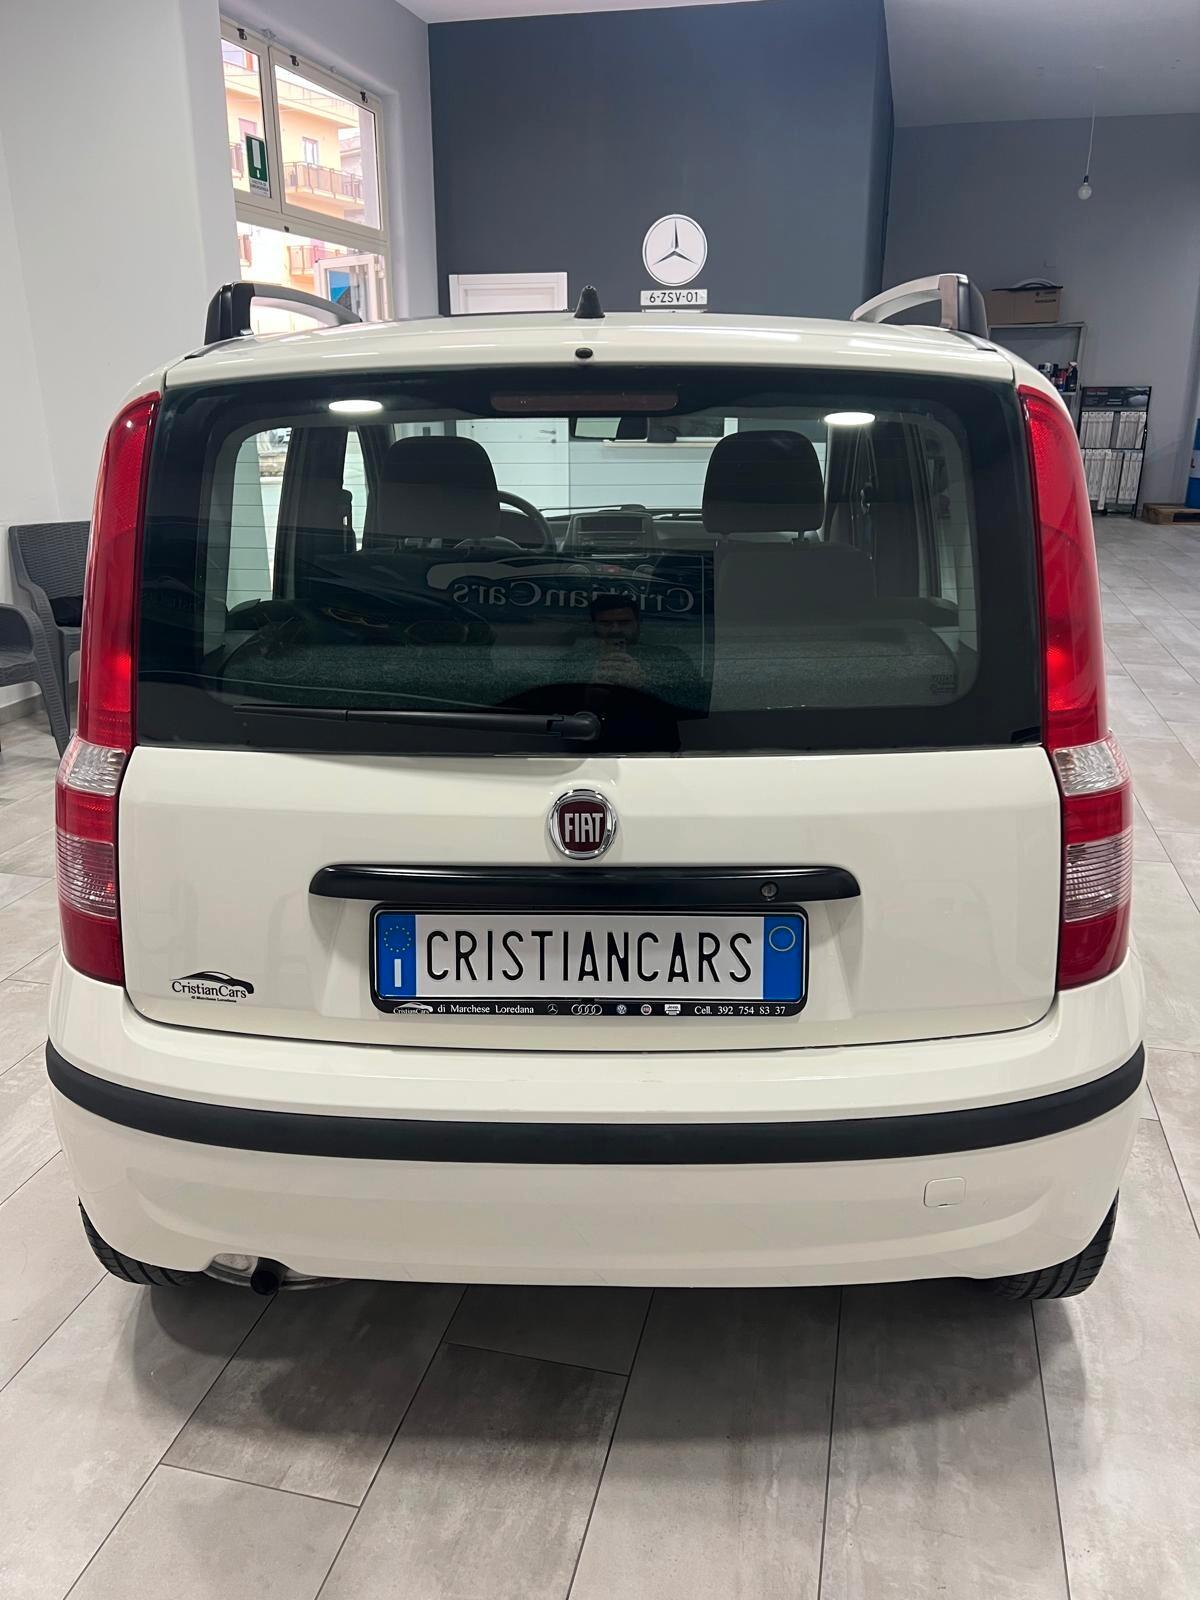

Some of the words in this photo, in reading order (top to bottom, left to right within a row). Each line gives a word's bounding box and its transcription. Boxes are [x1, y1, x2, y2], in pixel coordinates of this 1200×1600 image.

[649, 291, 699, 303] 6-ZSV-01
[564, 812, 604, 843] FIAT
[426, 930, 753, 984] CRISTIANCARS
[171, 980, 247, 999] CristianCars
[437, 1004, 447, 1014] di
[450, 1004, 491, 1014] Marchese
[495, 1005, 535, 1015] Loredana
[694, 1005, 713, 1015] Cell.
[717, 1005, 734, 1015] 392
[739, 1006, 755, 1015] 754
[759, 1006, 770, 1015] 83
[774, 1006, 786, 1016] 37
